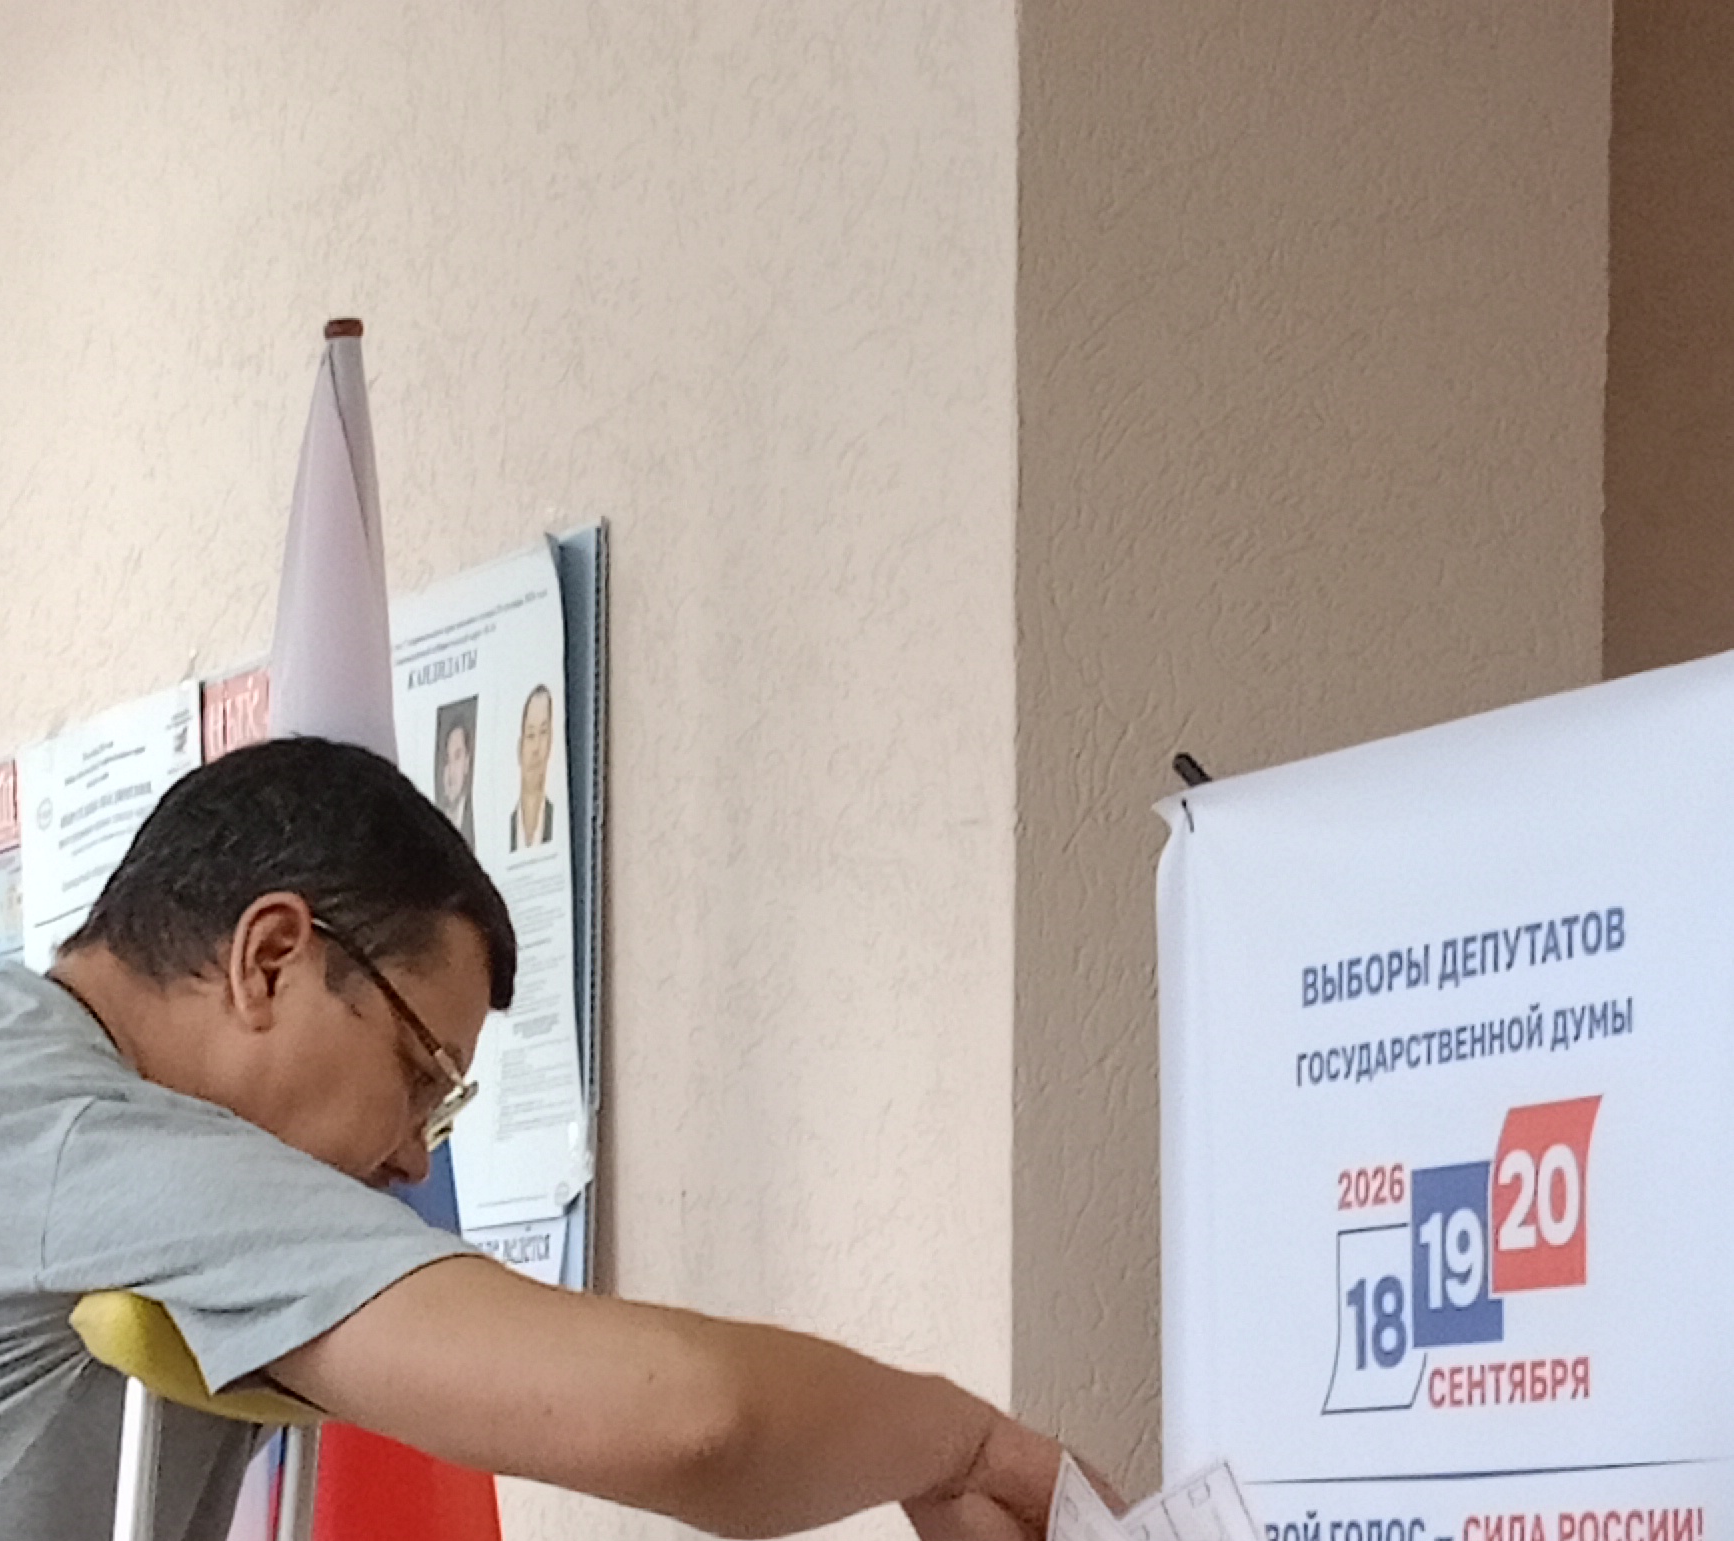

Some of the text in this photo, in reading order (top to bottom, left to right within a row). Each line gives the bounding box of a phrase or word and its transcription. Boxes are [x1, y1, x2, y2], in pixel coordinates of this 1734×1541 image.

[1301, 907, 1626, 1008] ВЫБОРЫ ДЕПУТАТОВ
[1296, 996, 1633, 1087] ГОСУДАРСТВЕННОЙ ДУМЫ
[1338, 1164, 1406, 1210] 2026
[1346, 1144, 1580, 1371] 18 19 20
[1427, 1356, 1591, 1409] СЕНТЯБРЯ
